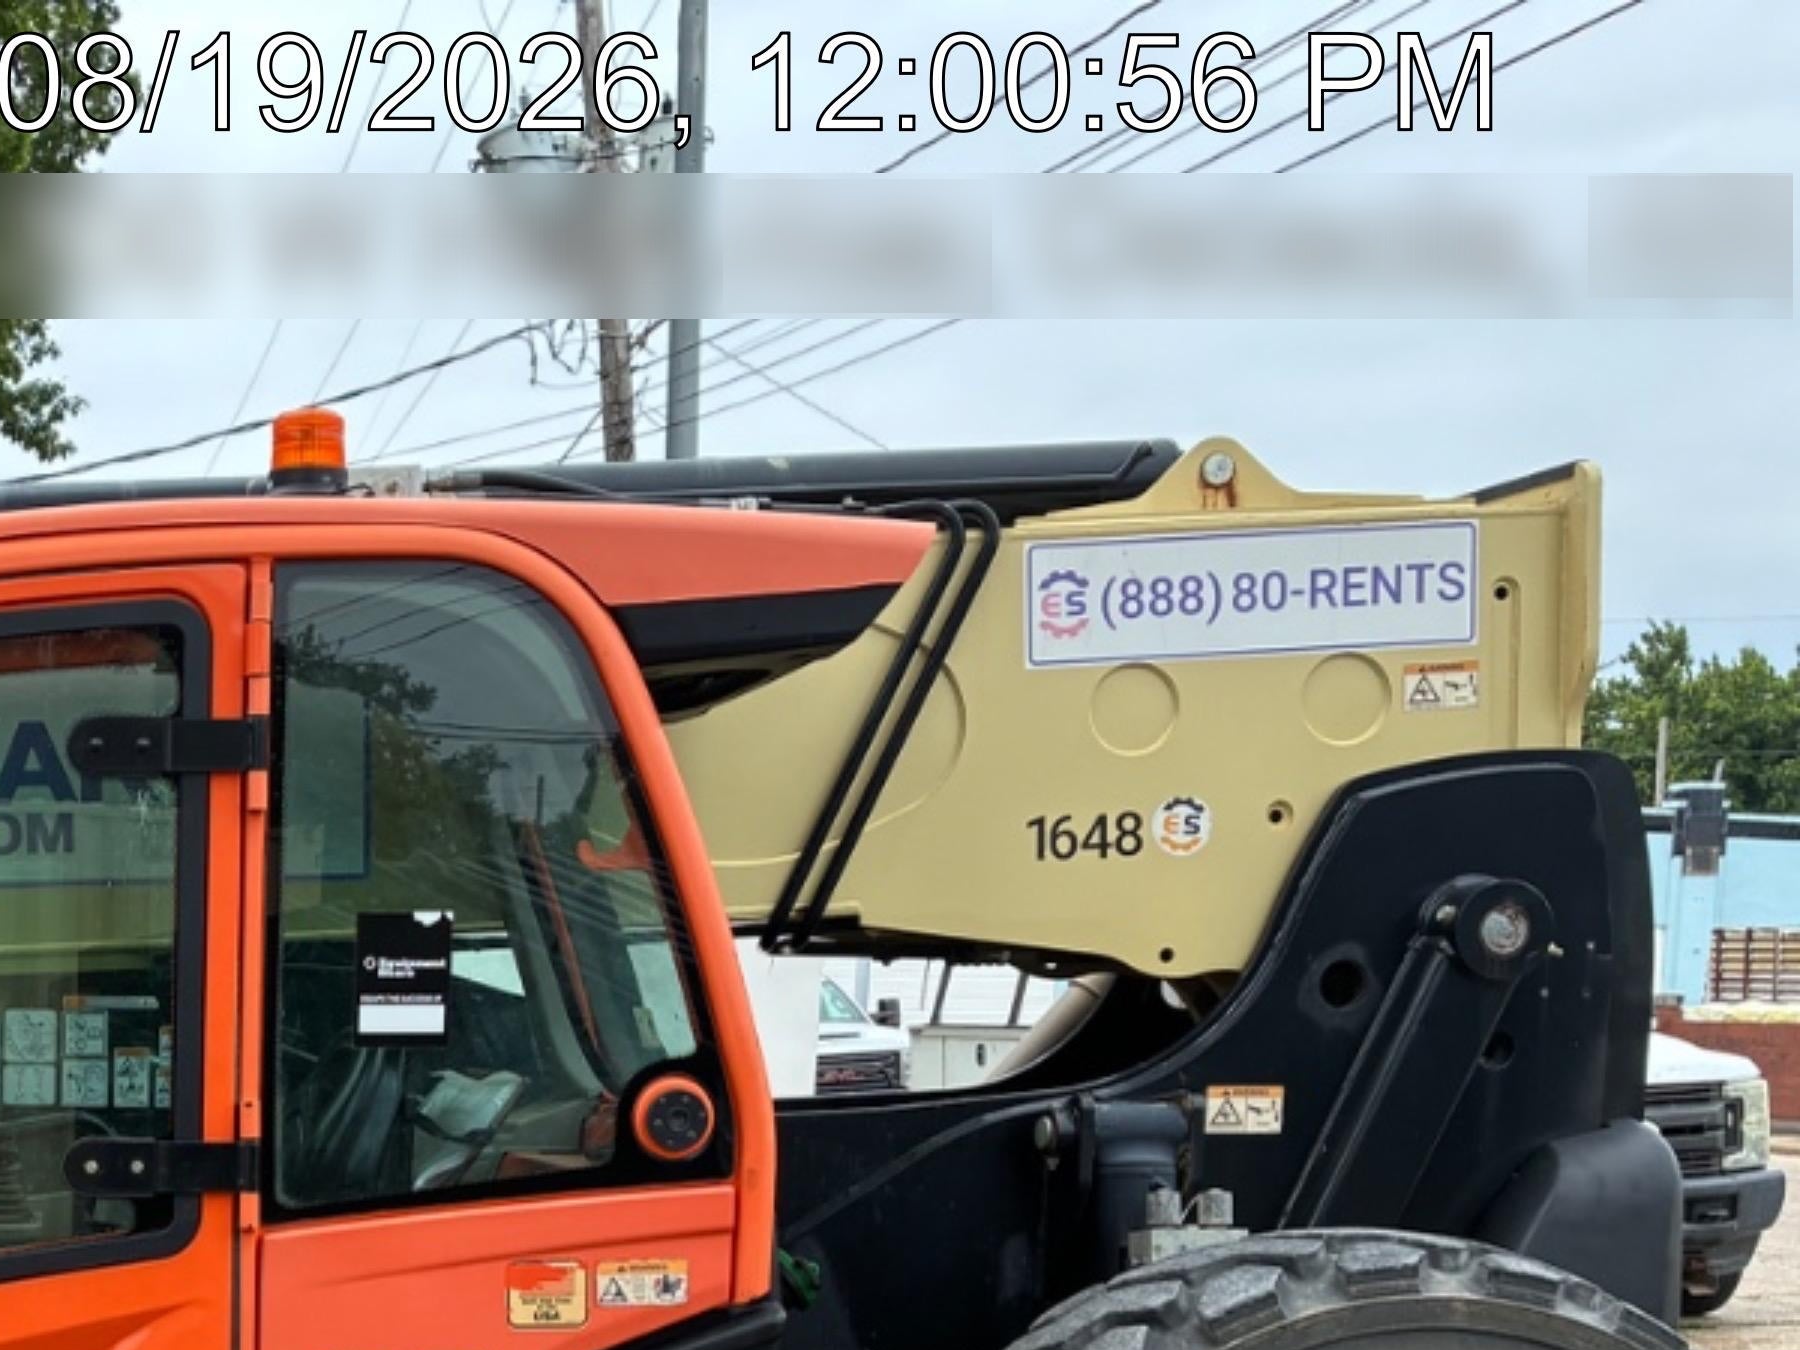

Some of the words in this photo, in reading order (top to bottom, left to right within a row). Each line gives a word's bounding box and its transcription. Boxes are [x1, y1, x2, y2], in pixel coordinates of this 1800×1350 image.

[1101, 571, 1222, 630] (888)
[1231, 561, 1467, 612] 80-RENTS
[1026, 812, 1144, 862] 1648
